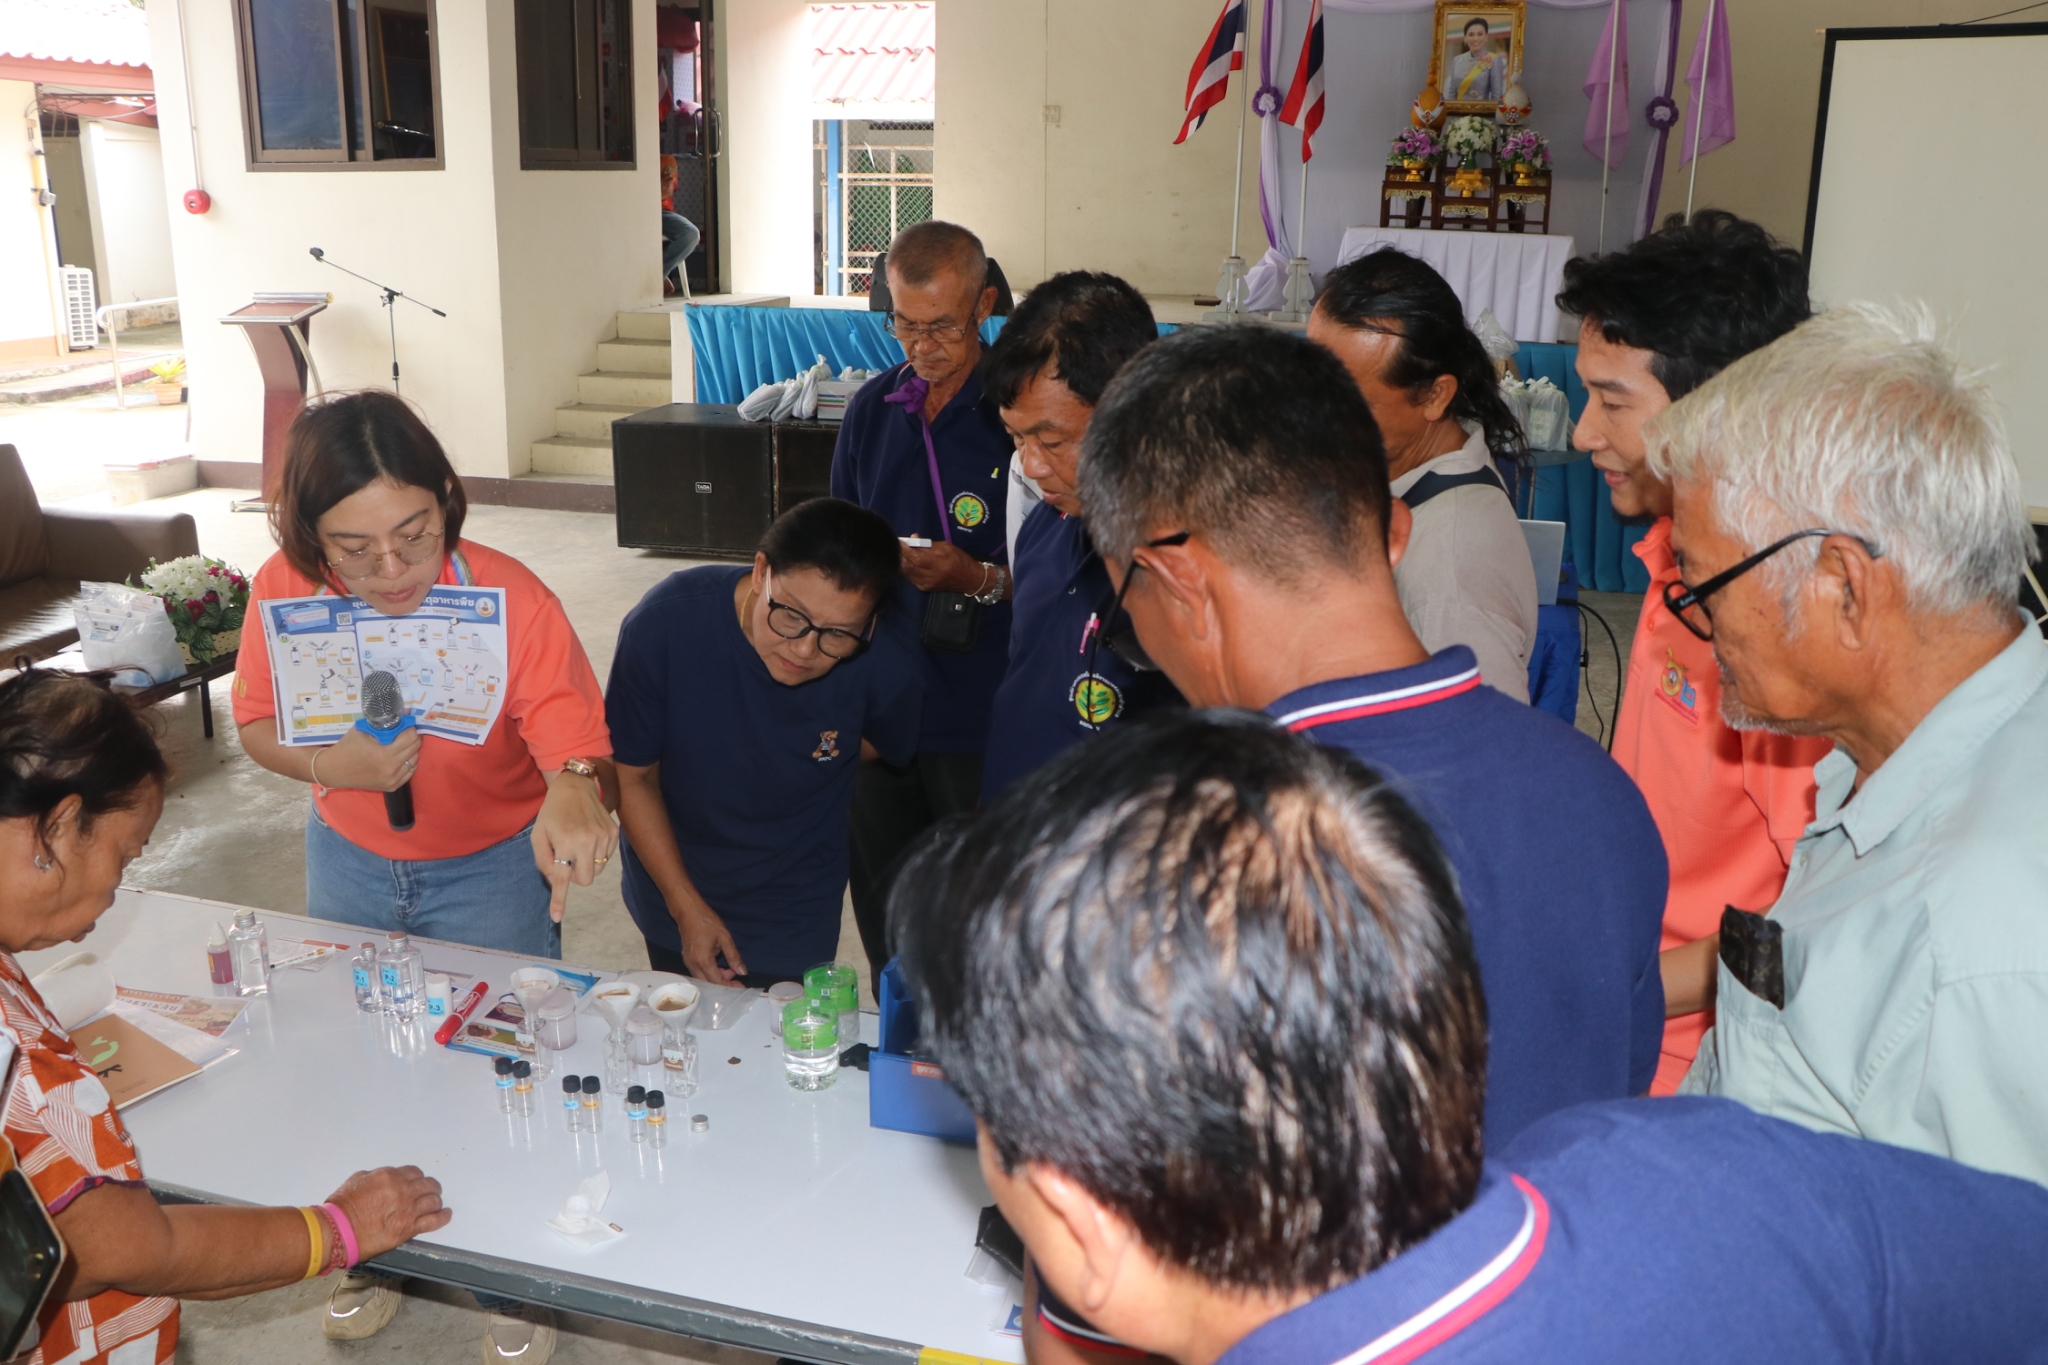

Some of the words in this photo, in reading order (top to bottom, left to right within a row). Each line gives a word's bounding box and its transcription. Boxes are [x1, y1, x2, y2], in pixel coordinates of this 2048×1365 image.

[355, 974, 365, 983] P-1
[385, 973, 395, 982] P-2
[429, 1003, 441, 1011] P-3
